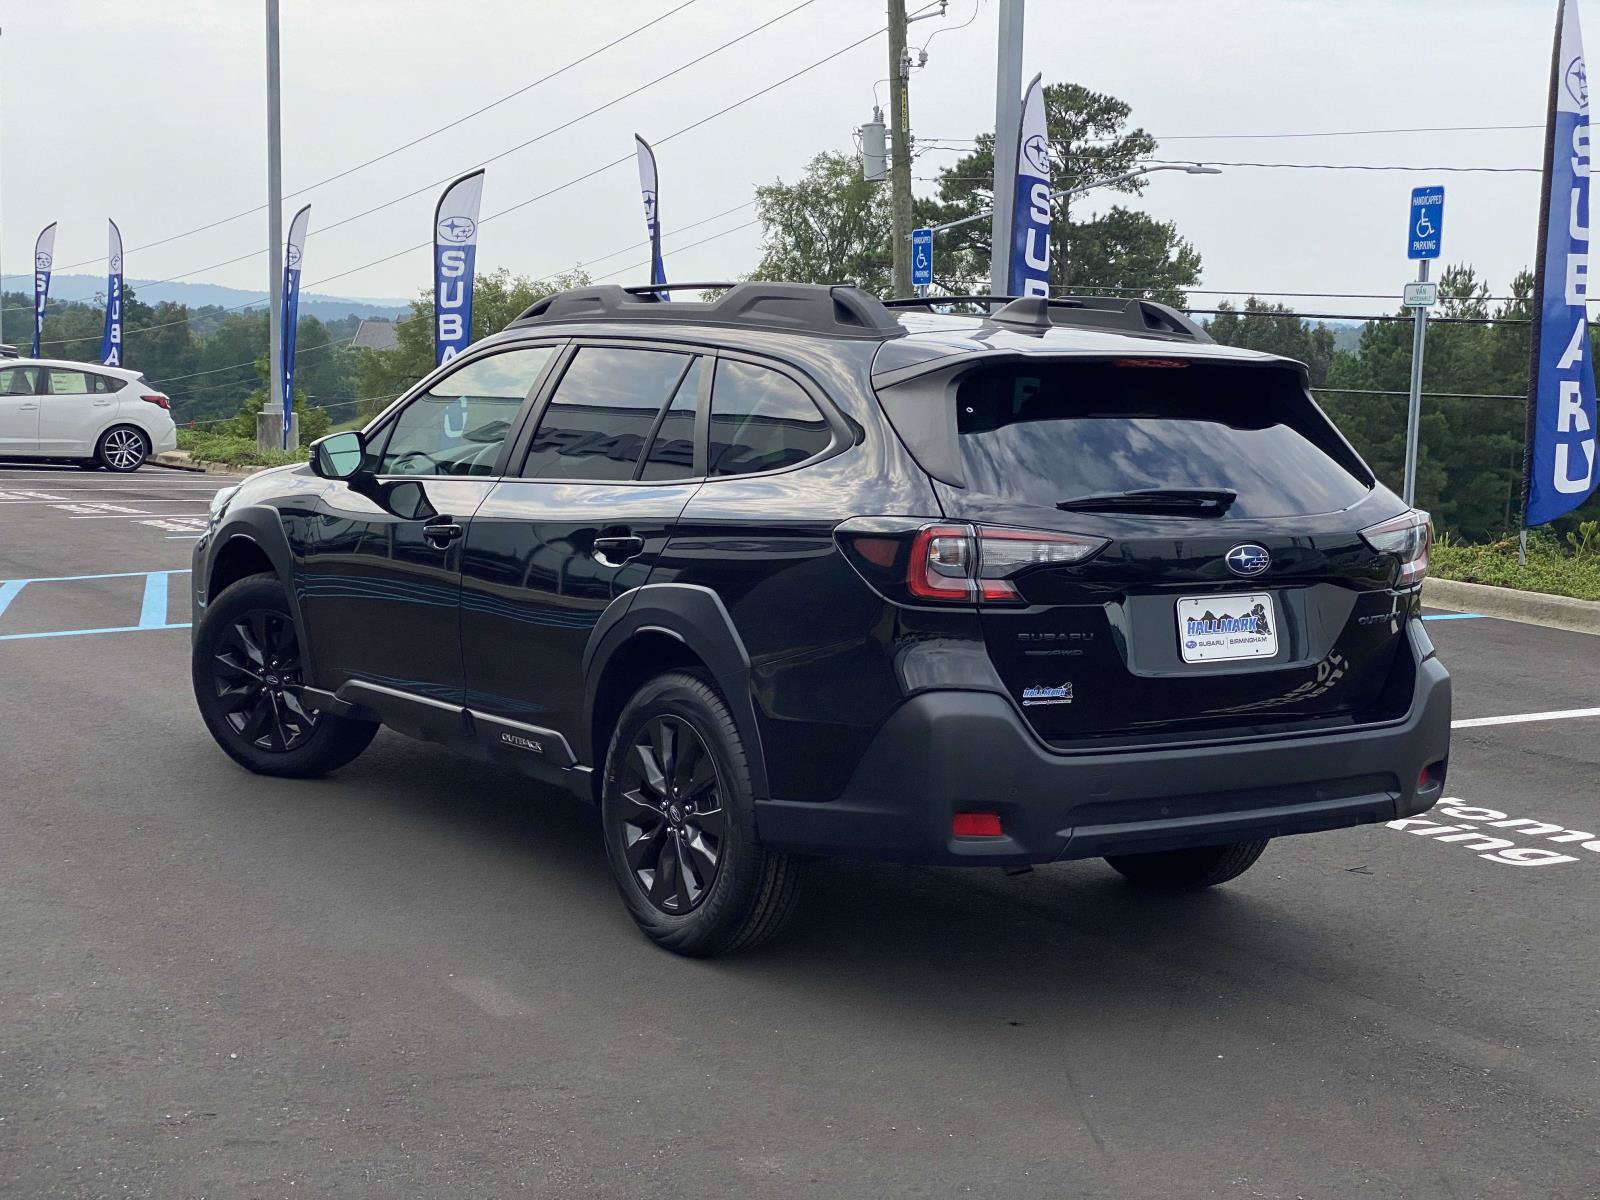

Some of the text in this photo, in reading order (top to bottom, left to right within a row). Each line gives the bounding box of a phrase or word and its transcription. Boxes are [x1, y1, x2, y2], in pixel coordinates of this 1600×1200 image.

[1412, 195, 1443, 206] HANDICAPPED
[1413, 240, 1436, 251] PARKING
[1187, 616, 1258, 635] HALLMARK
[1018, 633, 1094, 641] SUBARU
[1229, 636, 1268, 645] BIRMINGHAM
[501, 733, 543, 751] OUTBACK
